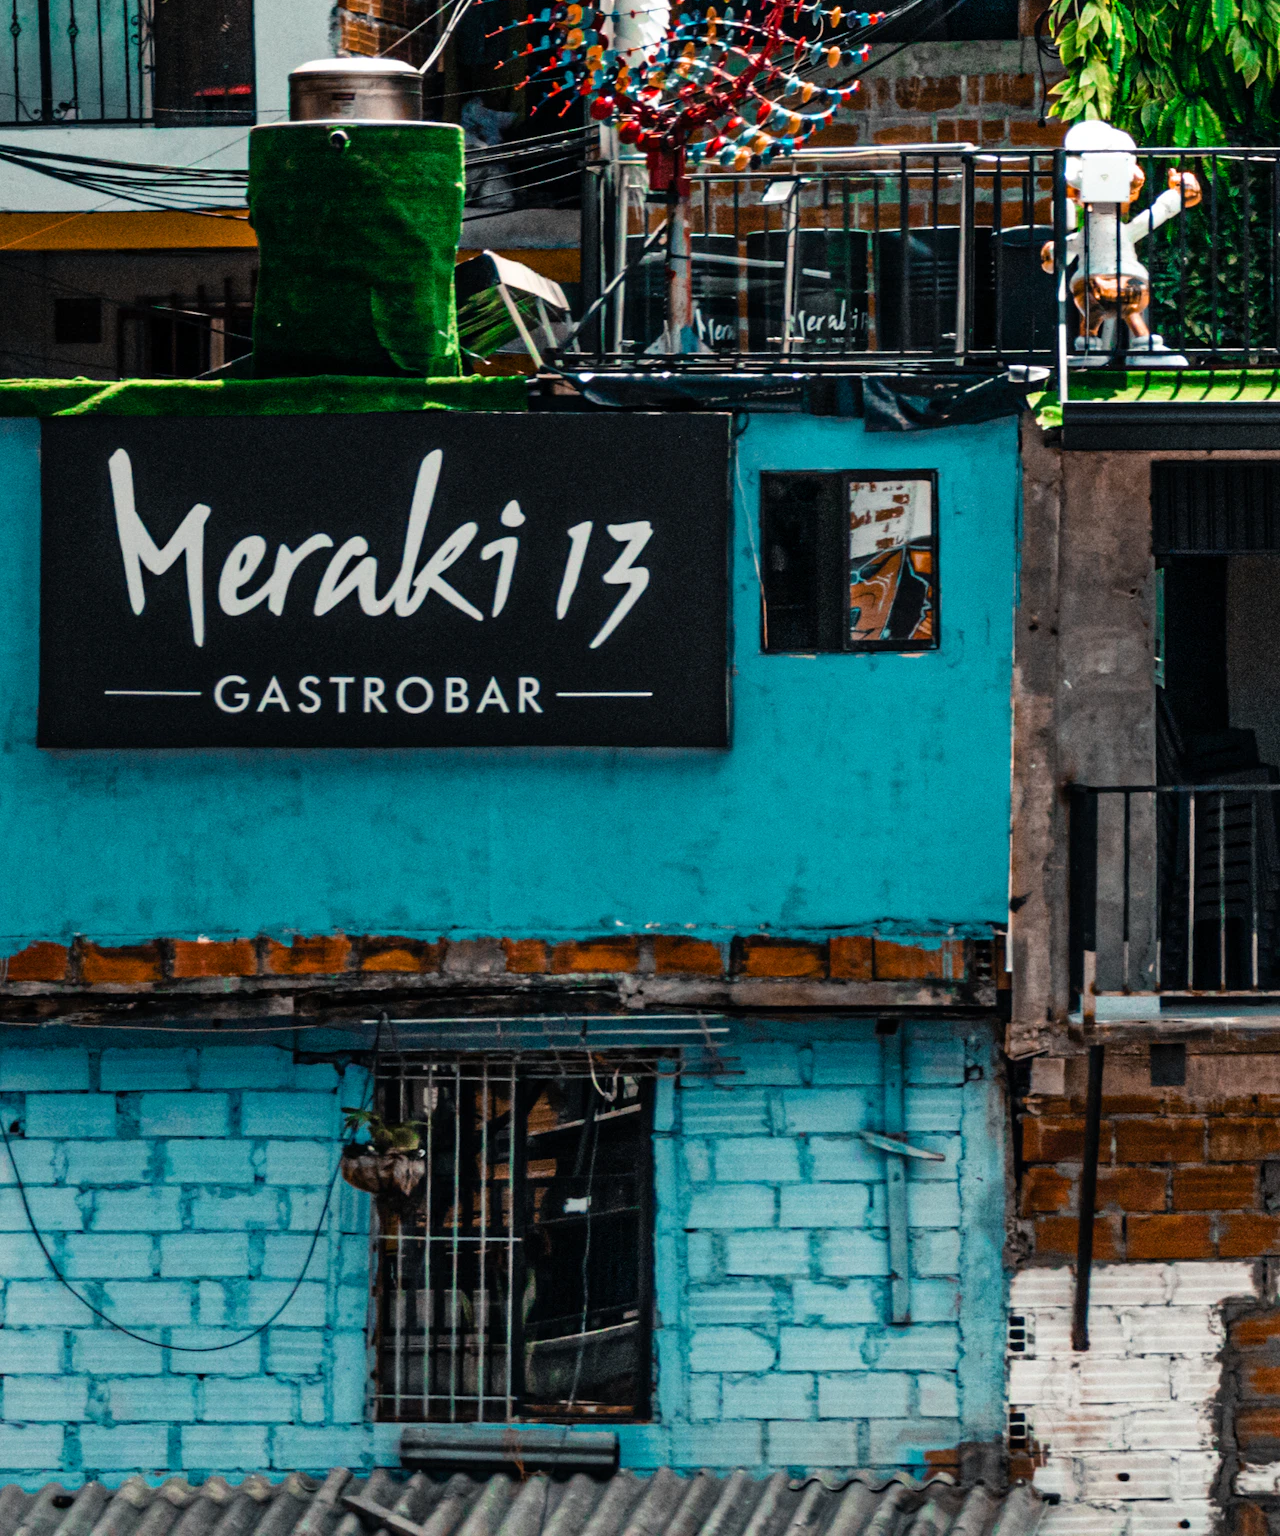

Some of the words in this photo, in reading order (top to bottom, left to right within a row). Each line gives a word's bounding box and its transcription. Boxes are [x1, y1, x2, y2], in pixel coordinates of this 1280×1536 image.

[108, 448, 527, 648] Meraki
[556, 520, 655, 649] 13
[213, 675, 545, 714] GASTROBAR
